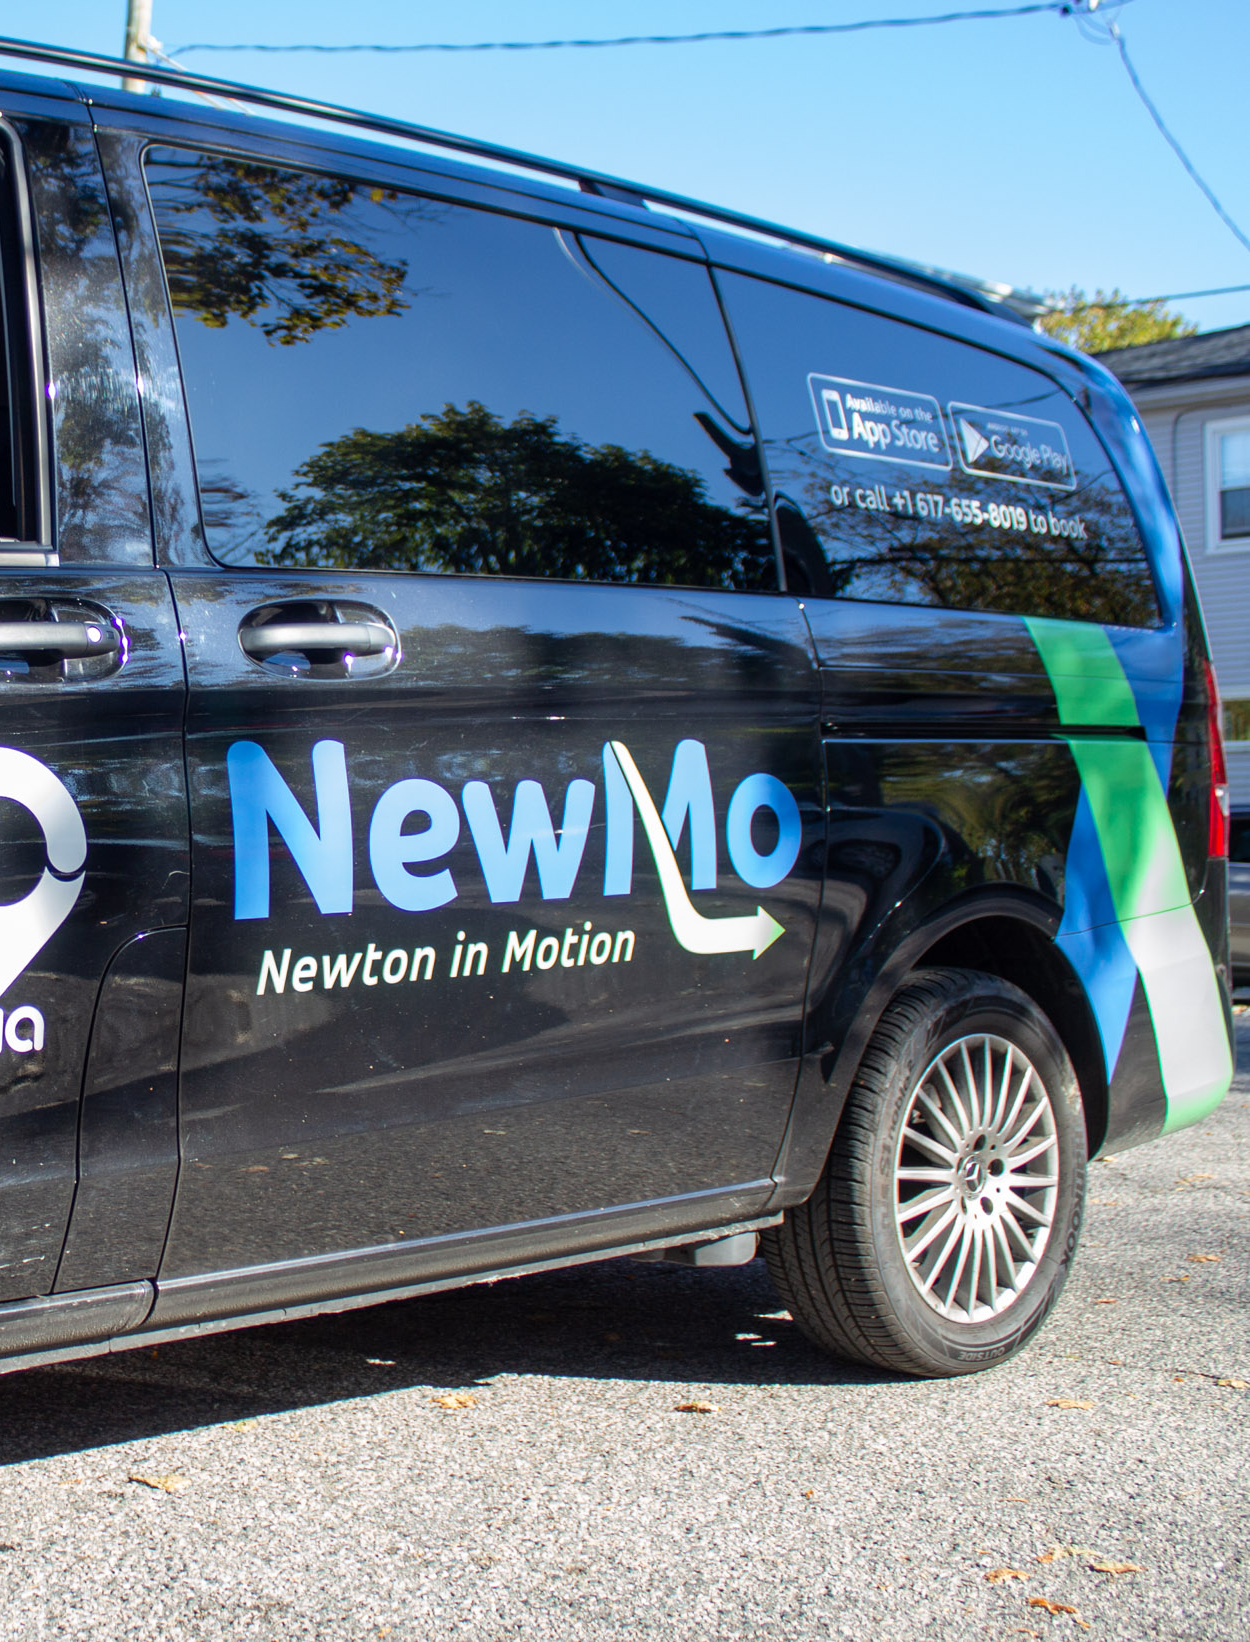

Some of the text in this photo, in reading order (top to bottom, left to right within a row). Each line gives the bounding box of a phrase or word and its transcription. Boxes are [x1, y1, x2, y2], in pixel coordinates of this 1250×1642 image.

[846, 393, 933, 423] Available on the
[852, 411, 940, 452] App Store
[990, 434, 1069, 475] Google Play
[830, 484, 1088, 540] or call +1 617-655-8019 to book
[227, 739, 802, 920] NewMo
[256, 920, 636, 996] Newton in Motion
[957, 1346, 1006, 1362] OUTSIDE
